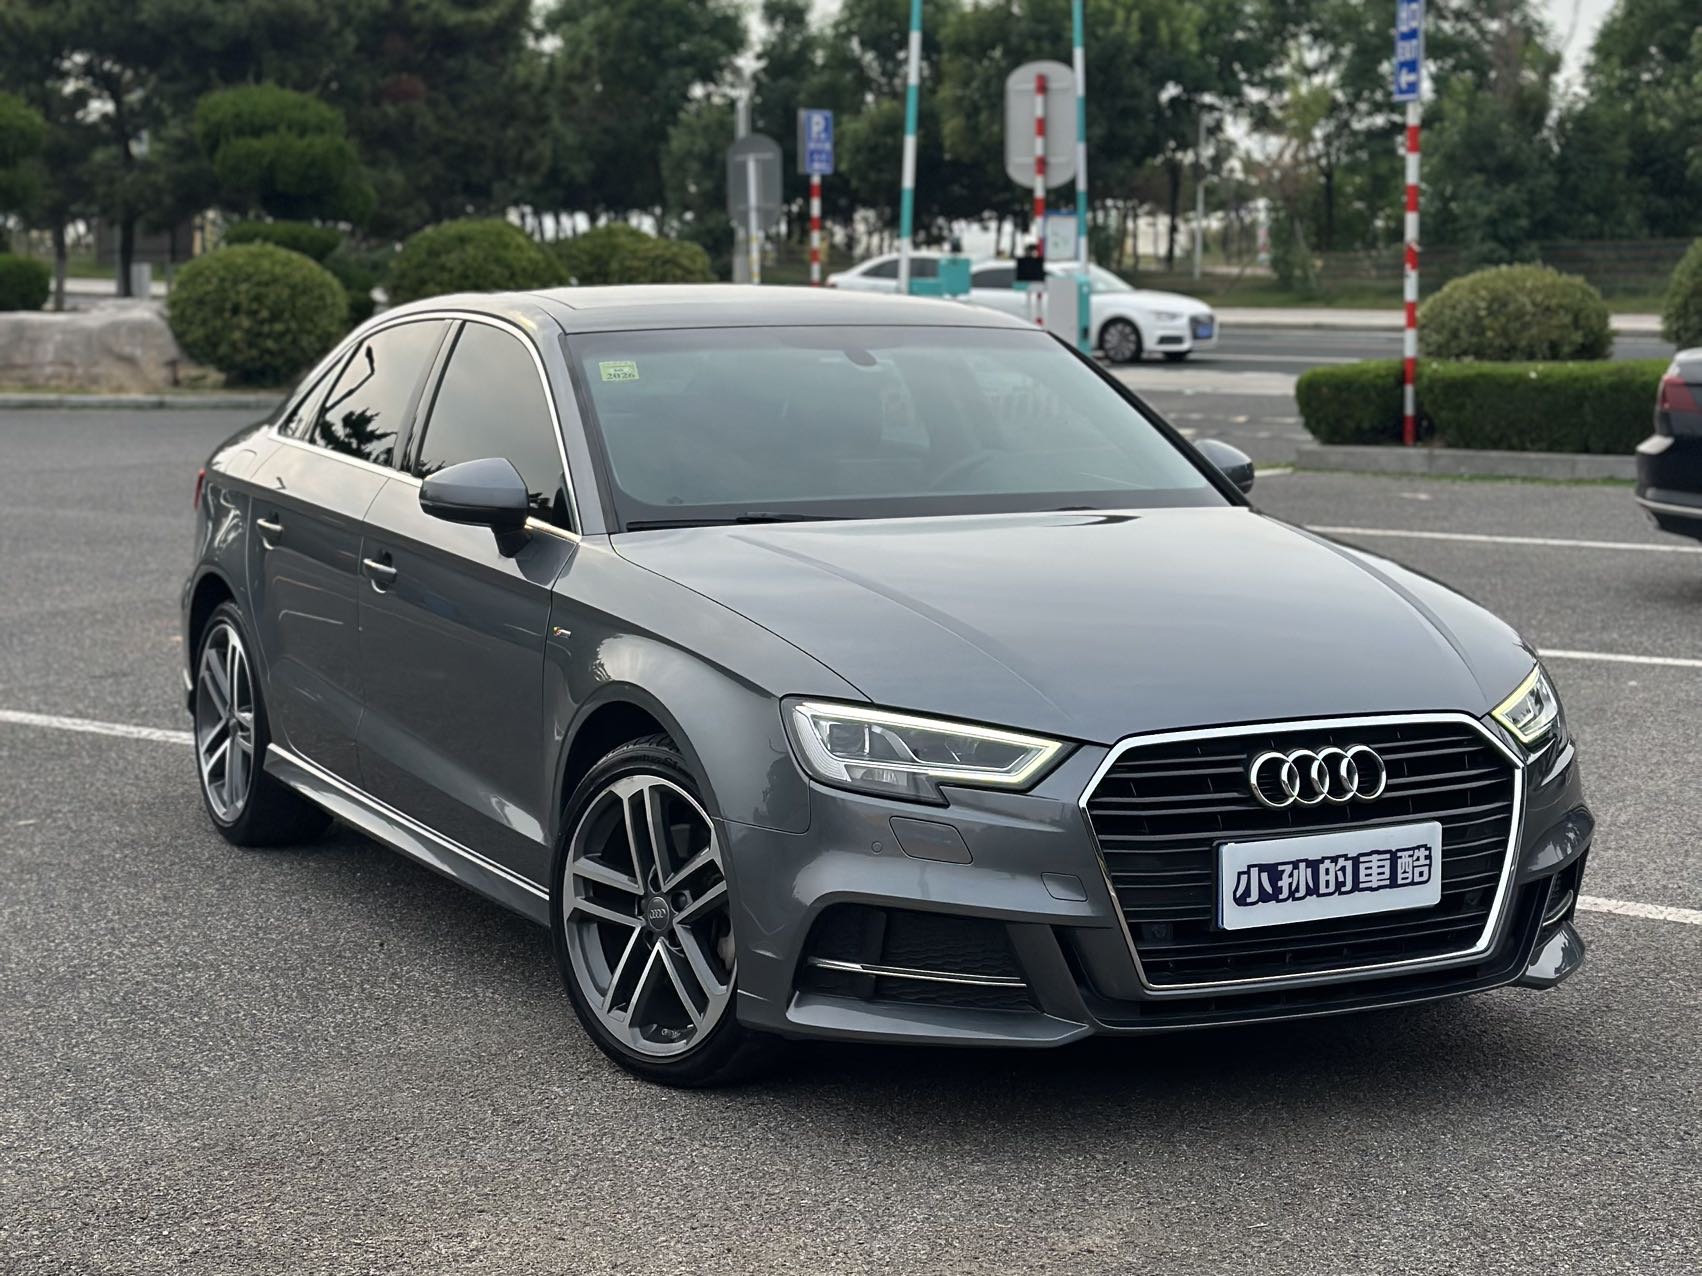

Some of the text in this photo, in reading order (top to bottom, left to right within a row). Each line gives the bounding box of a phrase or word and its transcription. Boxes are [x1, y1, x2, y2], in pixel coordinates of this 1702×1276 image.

[1234, 846, 1432, 905] 小孙的車酷
